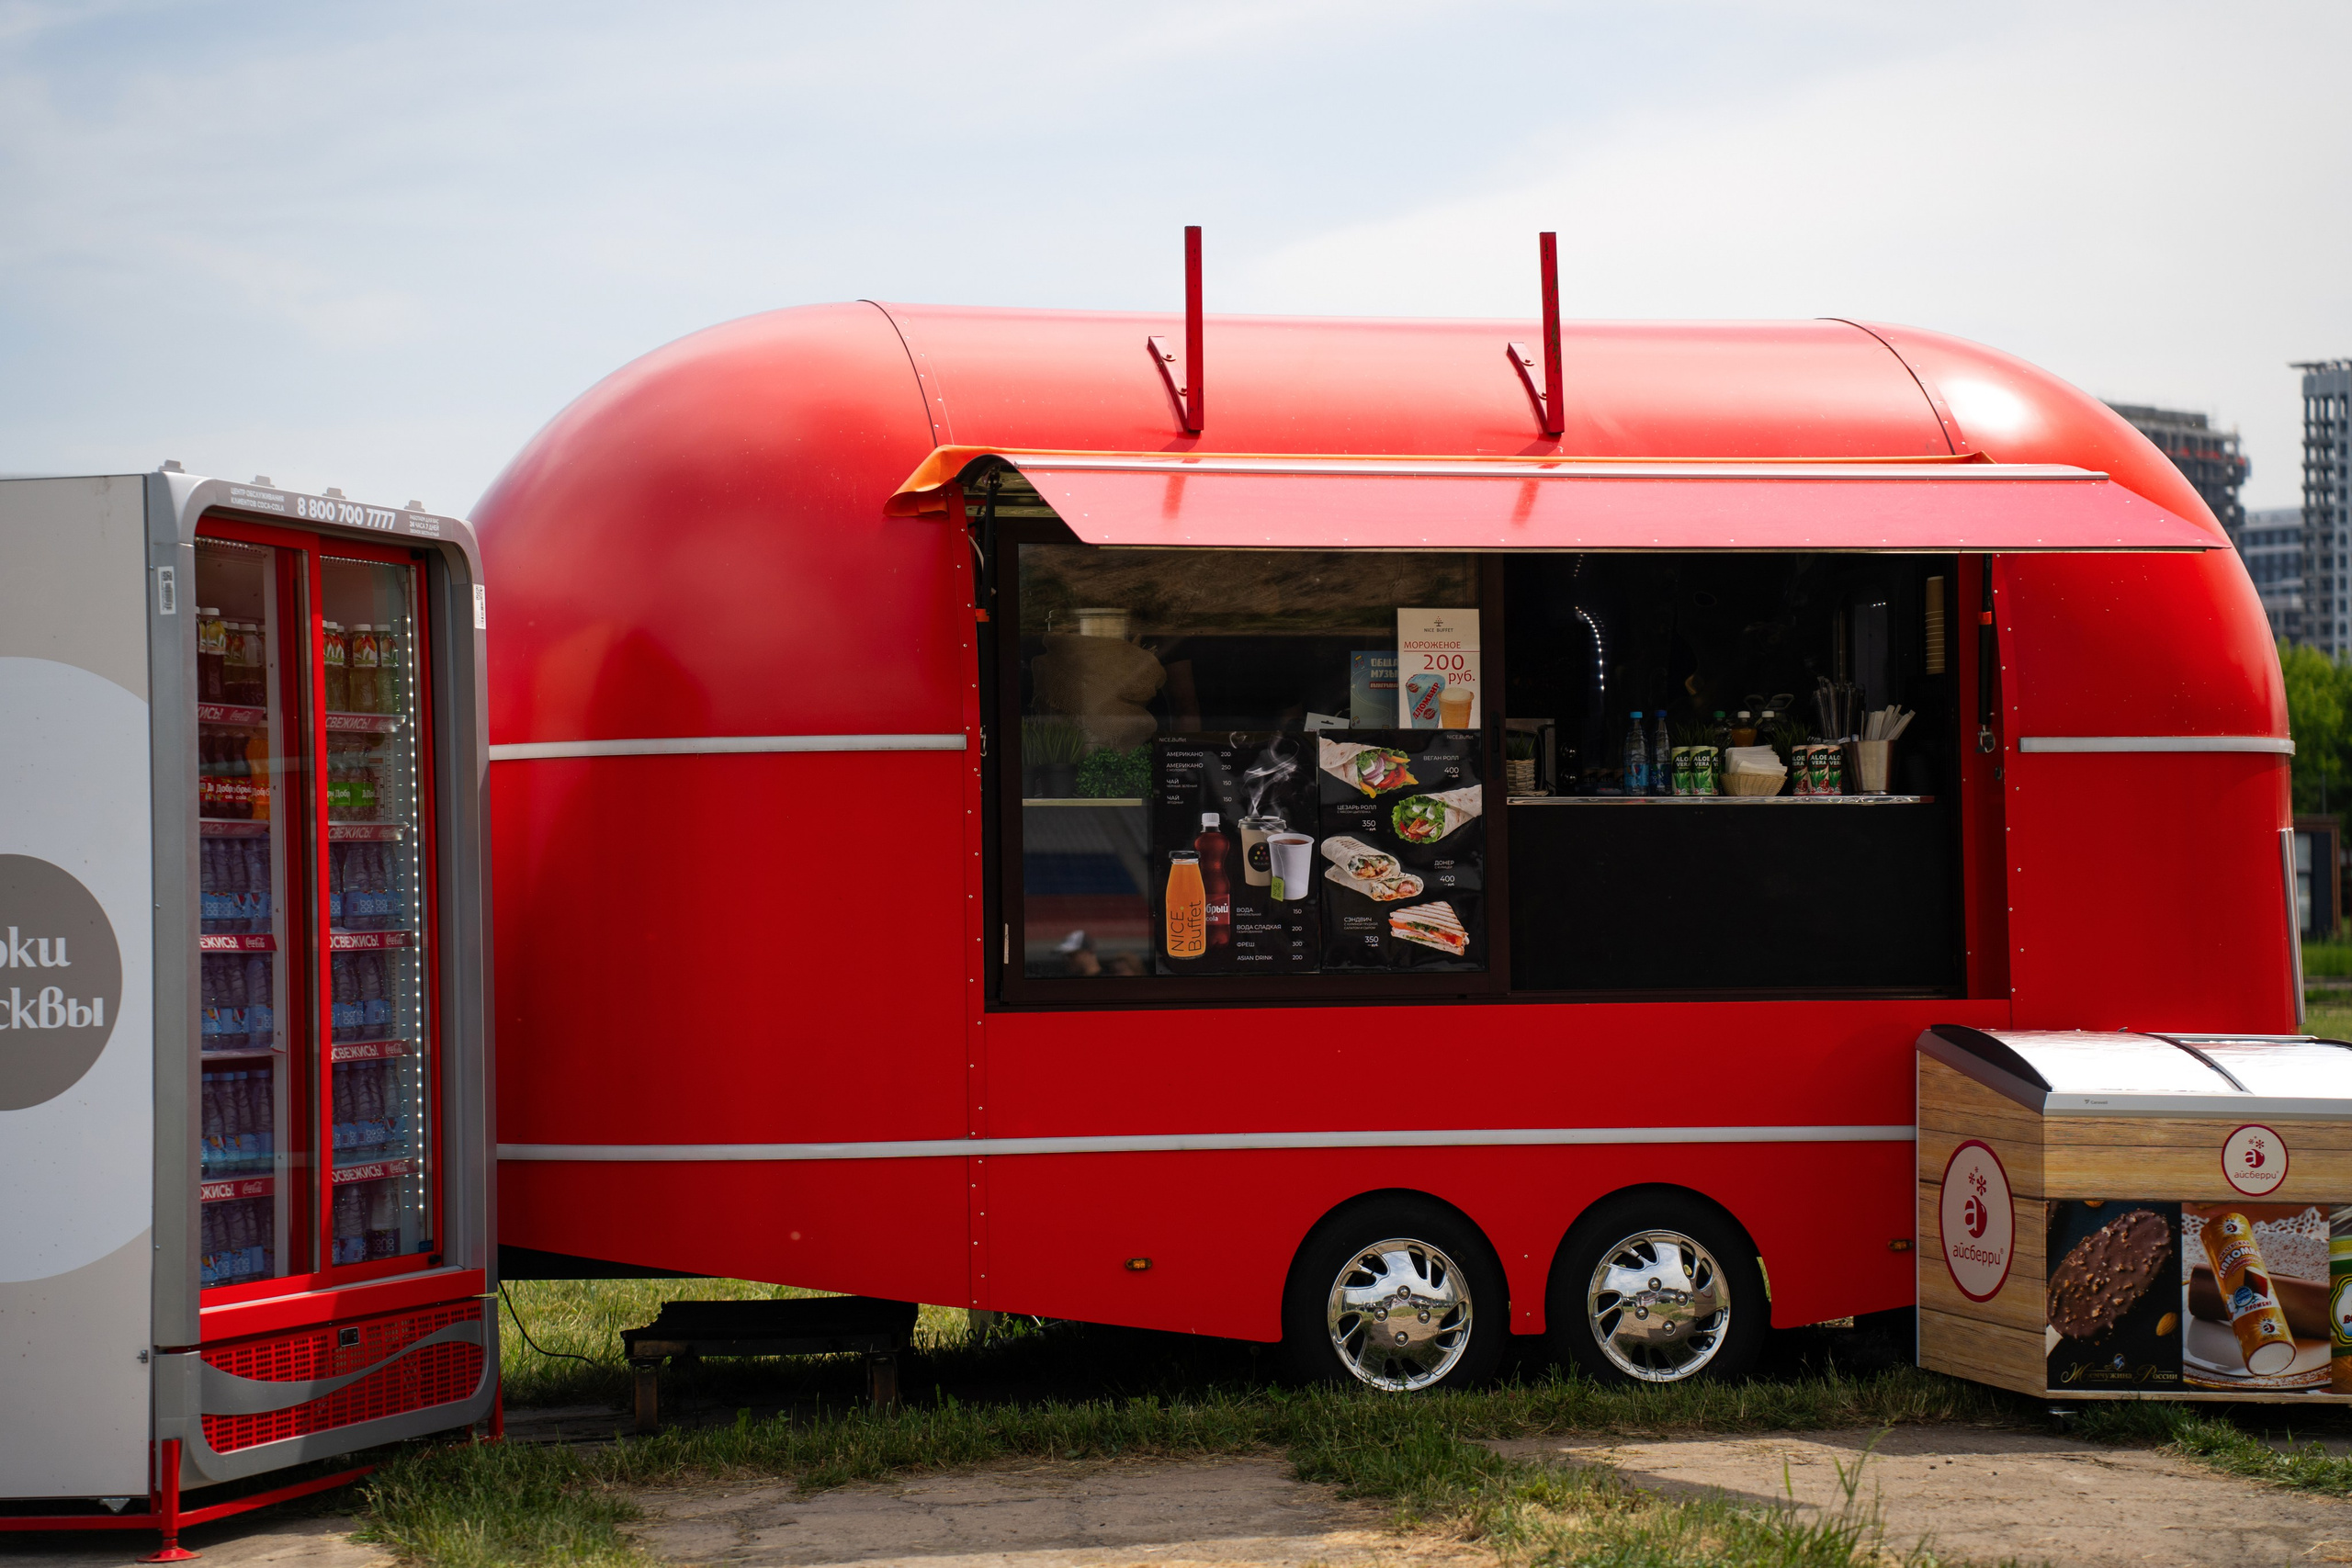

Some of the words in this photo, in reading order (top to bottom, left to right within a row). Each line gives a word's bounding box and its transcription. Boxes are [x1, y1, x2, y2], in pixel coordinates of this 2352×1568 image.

[297, 497, 307, 516] 8
[309, 499, 335, 521] 800
[338, 503, 364, 525] 700
[367, 508, 396, 530] 7777
[1423, 654, 1464, 670] 200
[1449, 670, 1476, 684] руб.
[1187, 900, 1202, 952] Buffet
[2233, 1170, 2277, 1180] айсберри
[1952, 1242, 2001, 1268] айсберри
